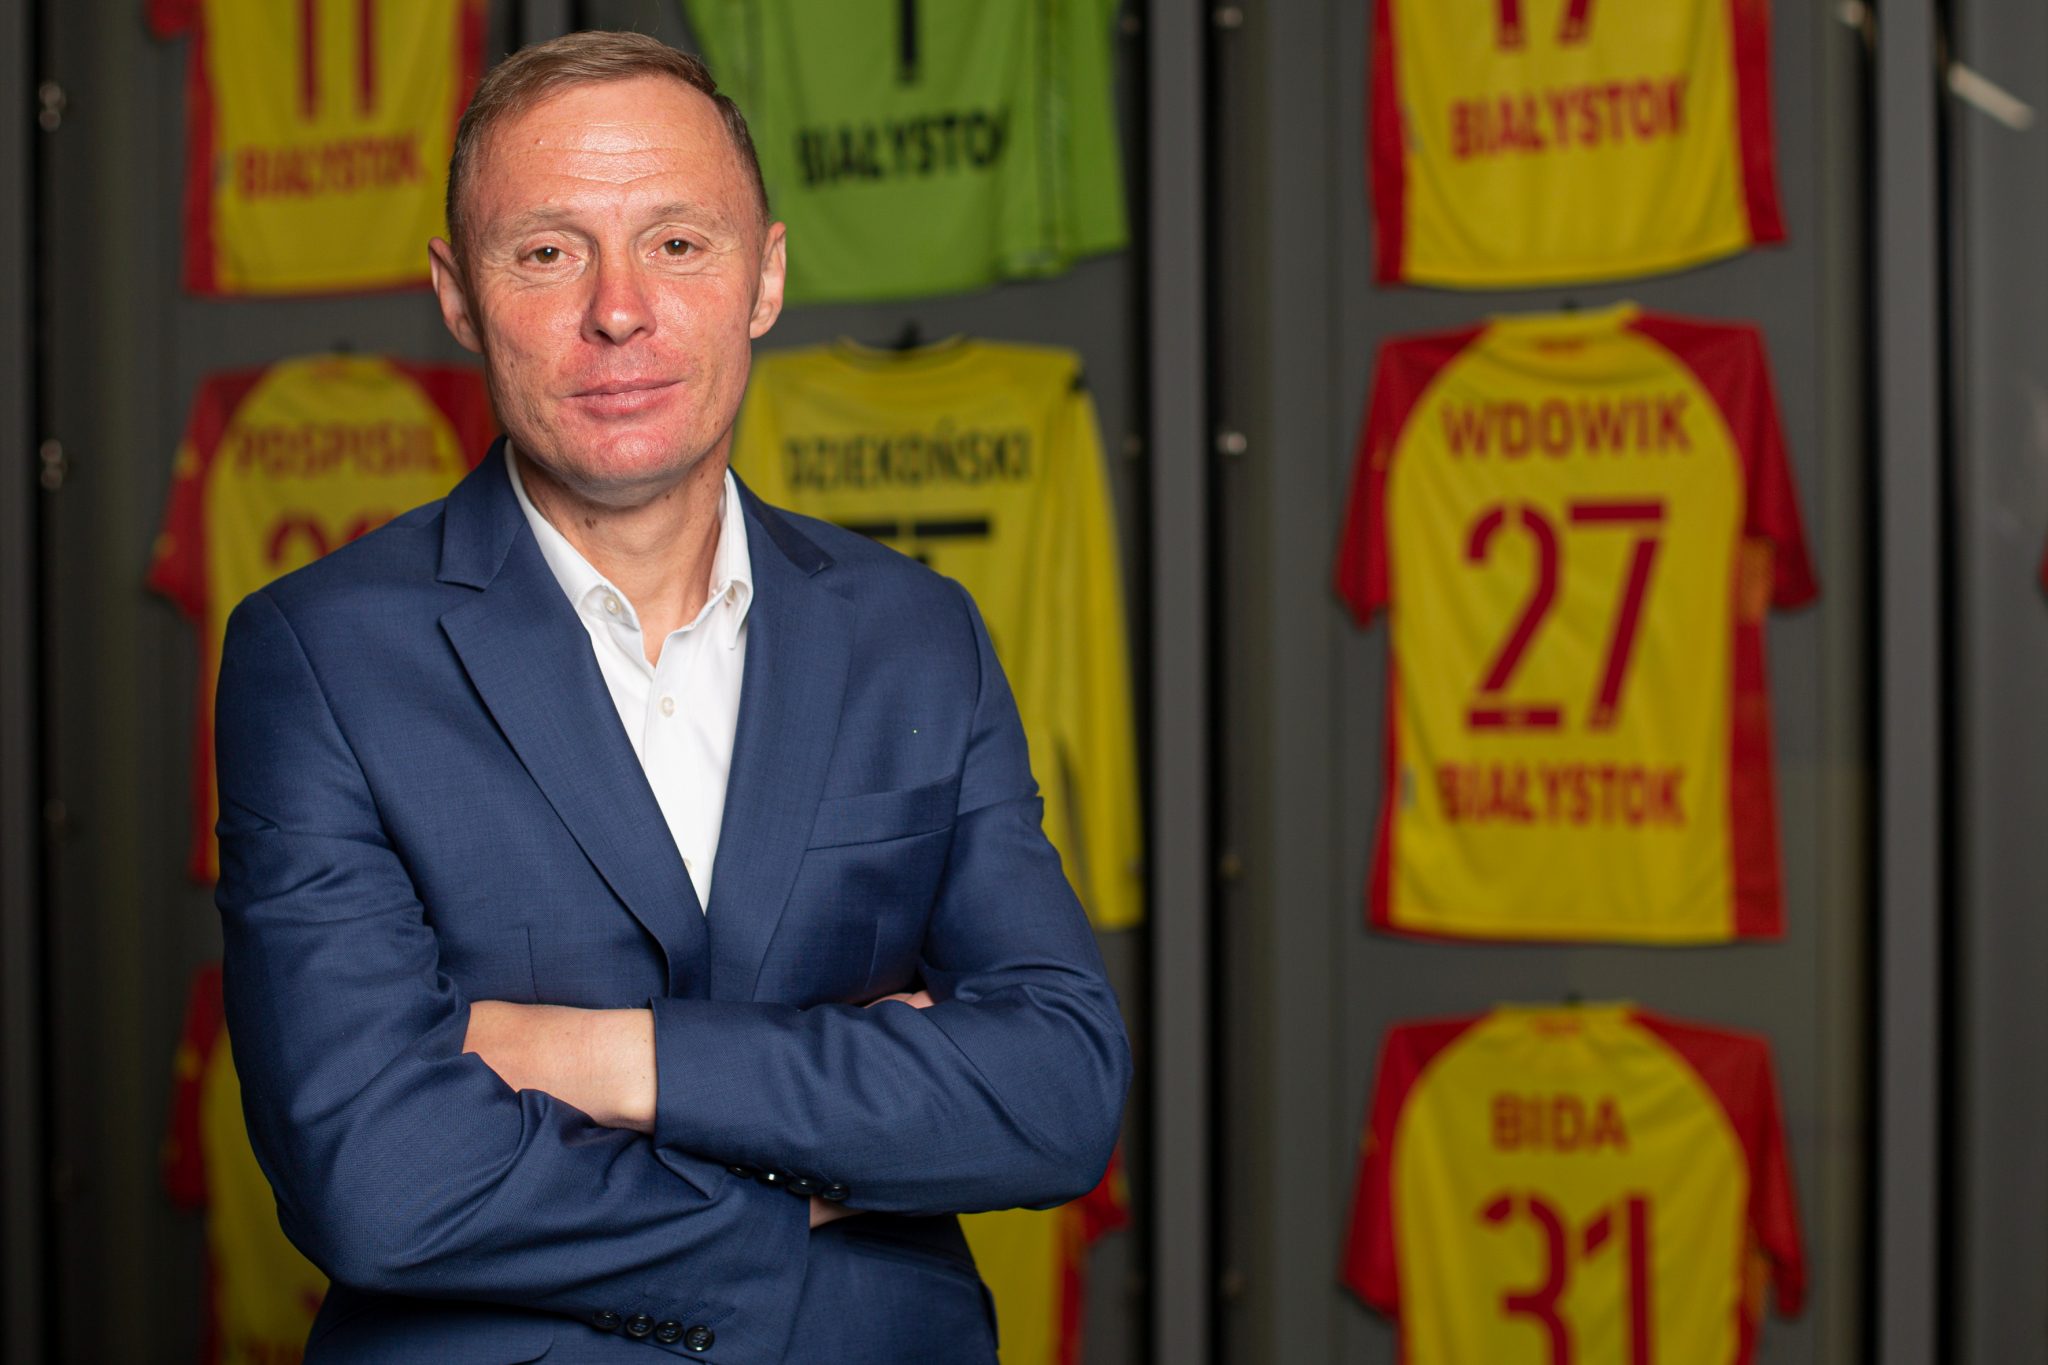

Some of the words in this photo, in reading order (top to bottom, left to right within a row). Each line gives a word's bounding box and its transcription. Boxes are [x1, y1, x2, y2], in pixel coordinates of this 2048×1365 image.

[1441, 394, 1693, 459] WDOWIK
[1464, 499, 1668, 734] 27
[1436, 762, 1688, 827] BIAŁYSTOK
[1491, 1091, 1630, 1152] BIDA
[1478, 1192, 1652, 1365] 31
